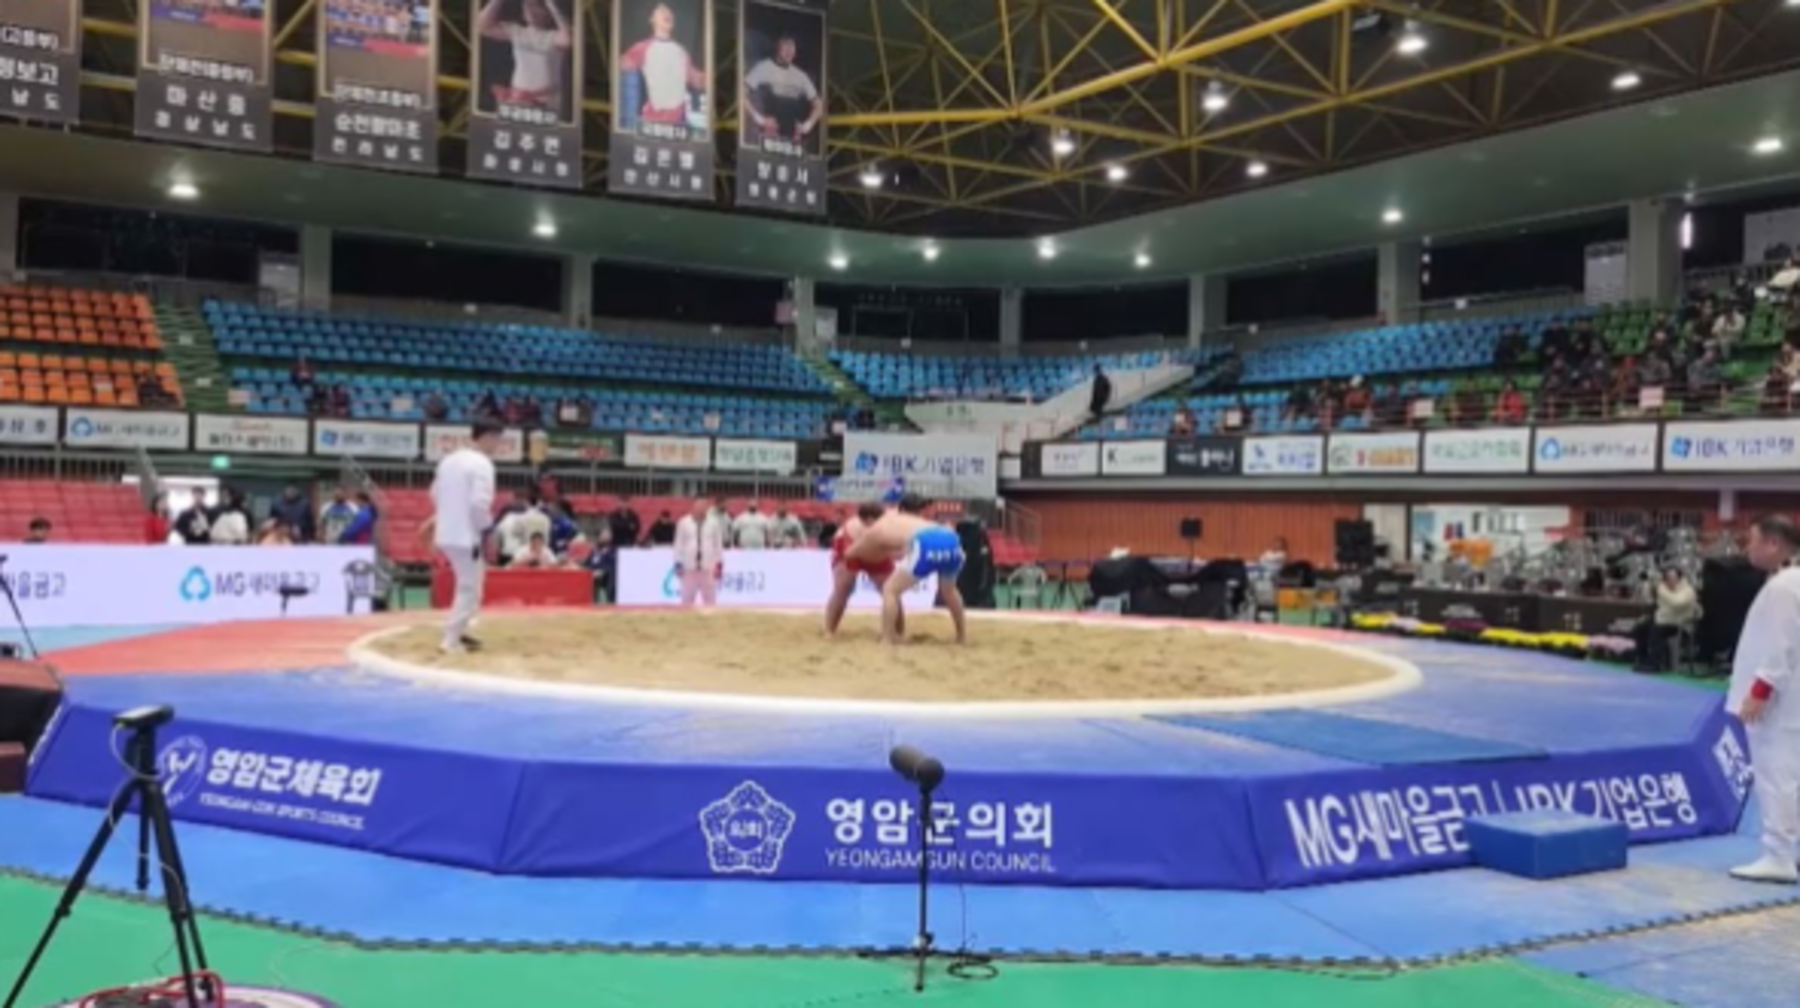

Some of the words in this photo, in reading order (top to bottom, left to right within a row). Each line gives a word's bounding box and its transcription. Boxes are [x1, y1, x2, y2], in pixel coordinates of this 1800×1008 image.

[206, 747, 382, 806] 영암군체육회
[1581, 772, 1697, 829] 기업은행
[825, 798, 1053, 848] 영암군의회
[971, 853, 1057, 873] COUNCIL
